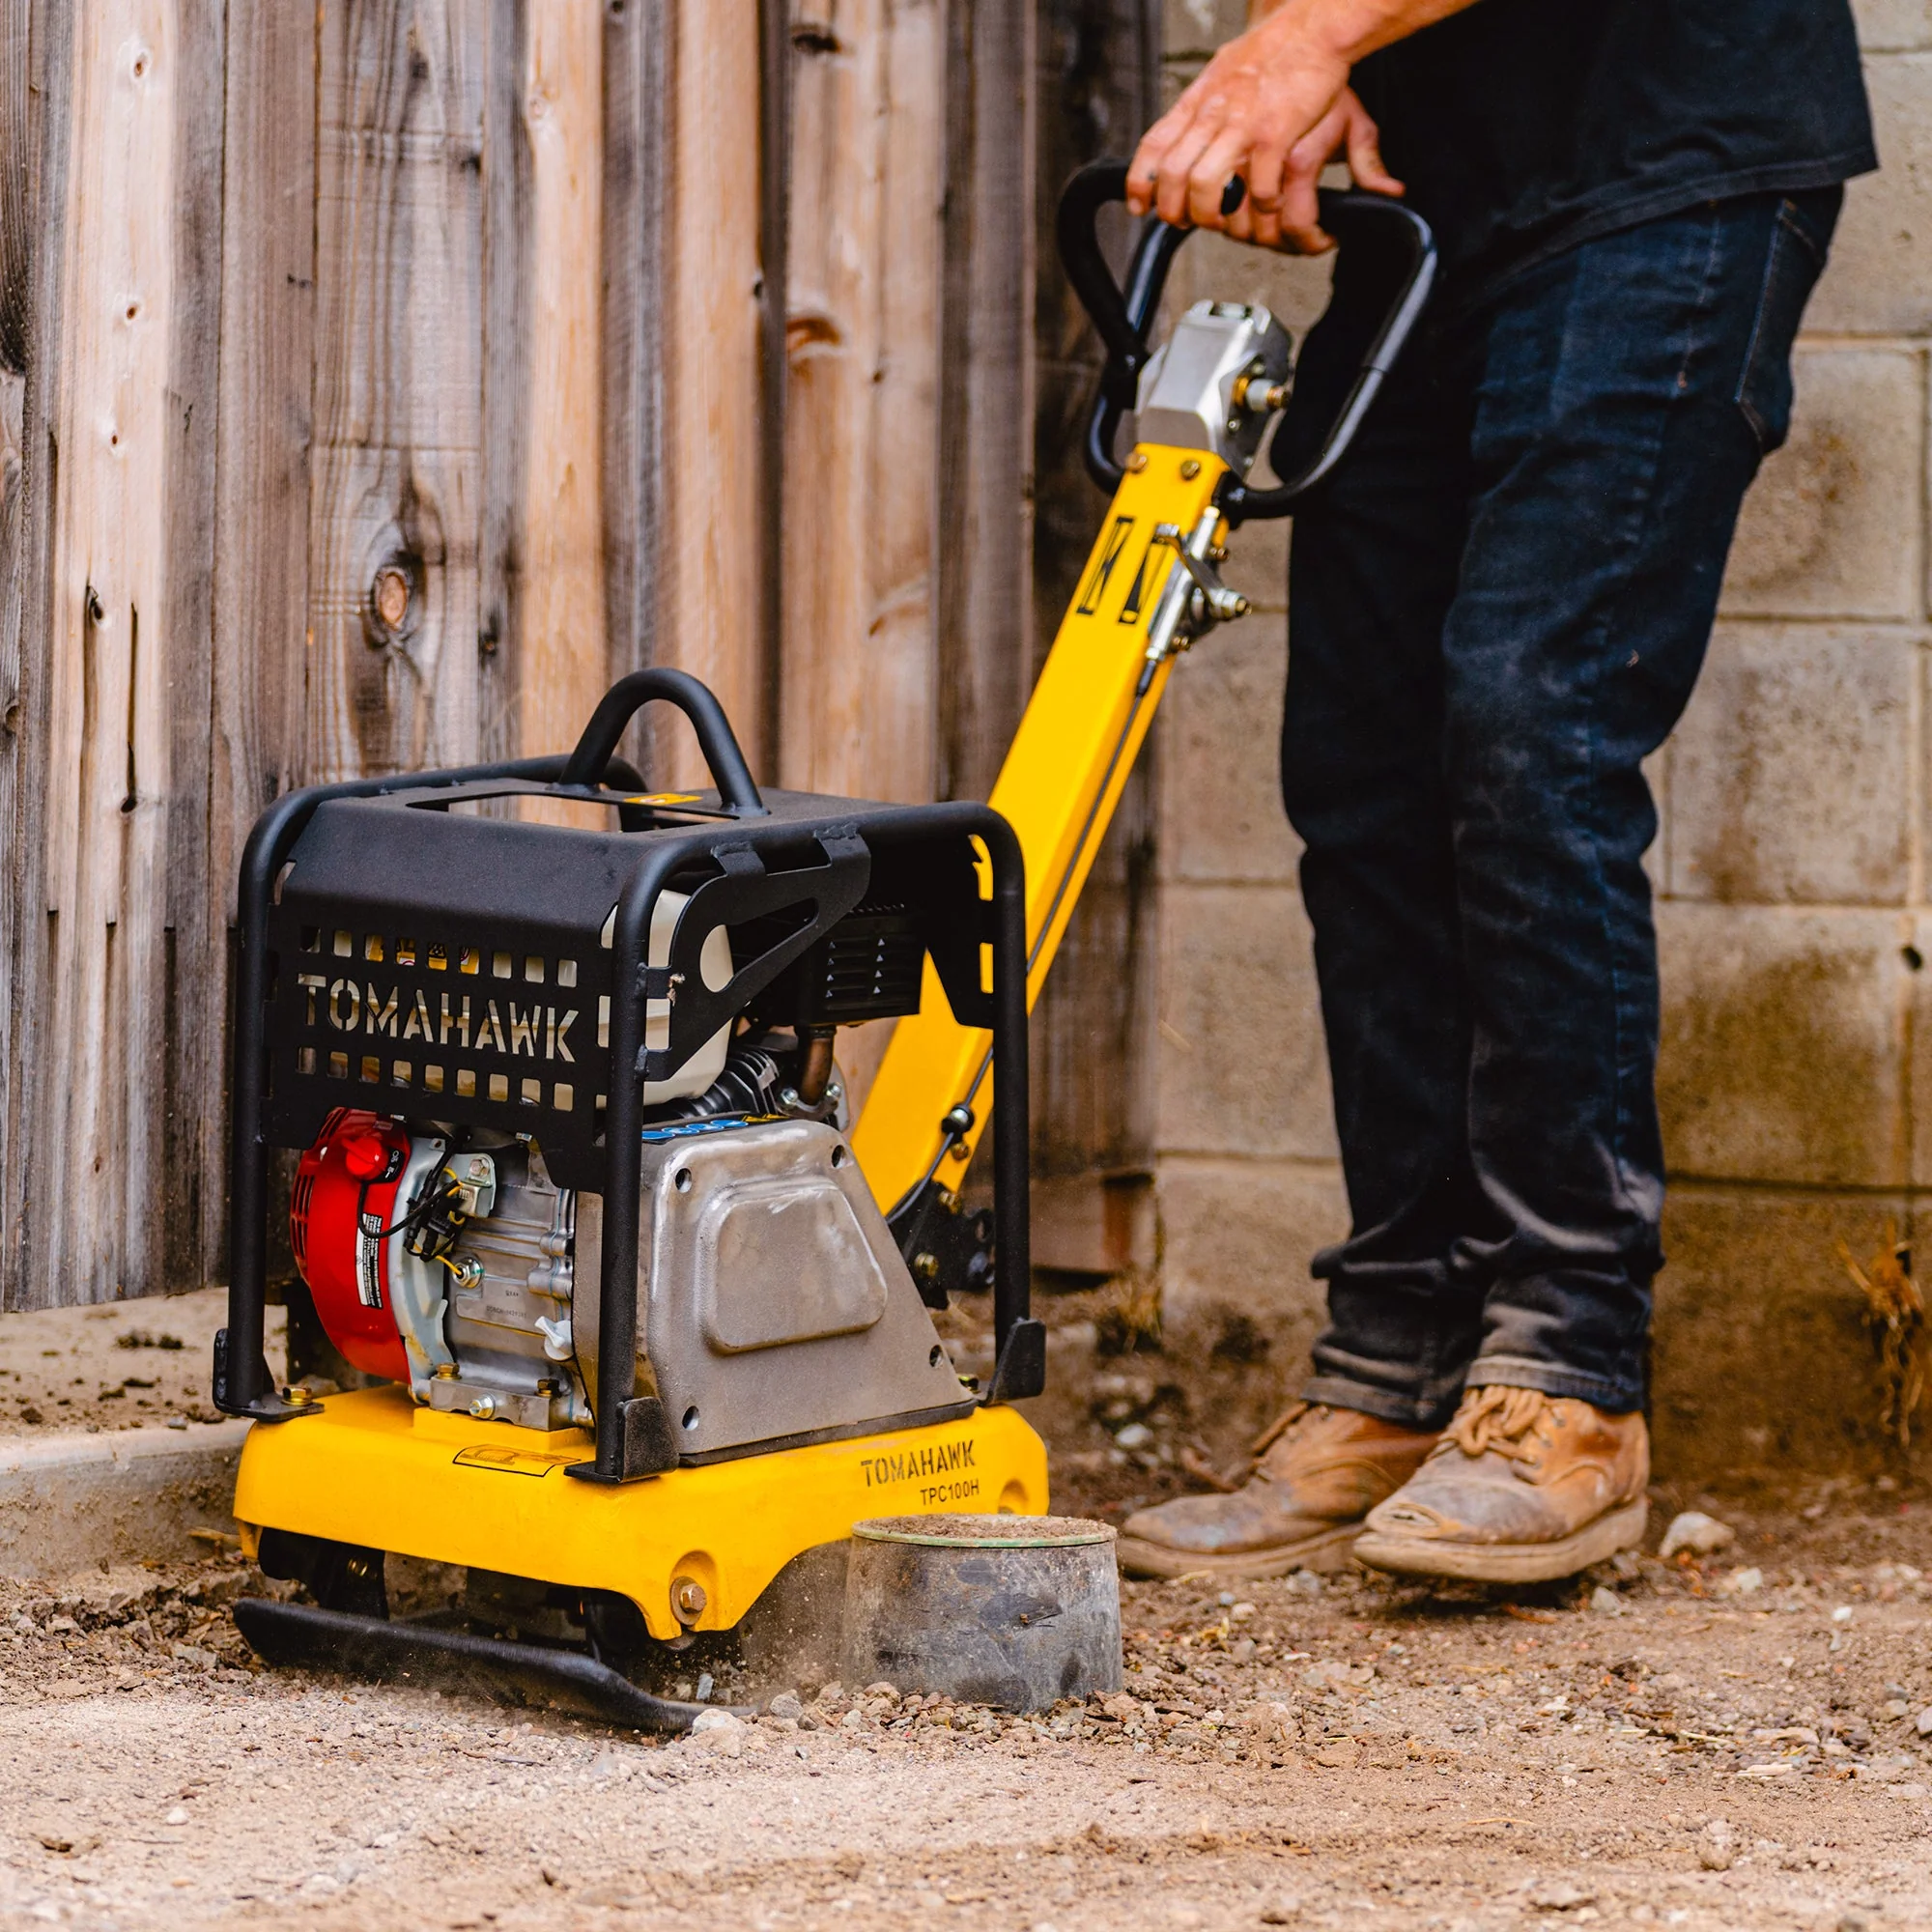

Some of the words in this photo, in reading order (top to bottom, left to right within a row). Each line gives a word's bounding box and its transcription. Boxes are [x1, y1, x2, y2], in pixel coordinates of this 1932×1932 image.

[297, 973, 579, 1063] TOMAHAWK
[861, 1439, 976, 1487] TOMAHAWK
[920, 1479, 980, 1505] TPC100H
